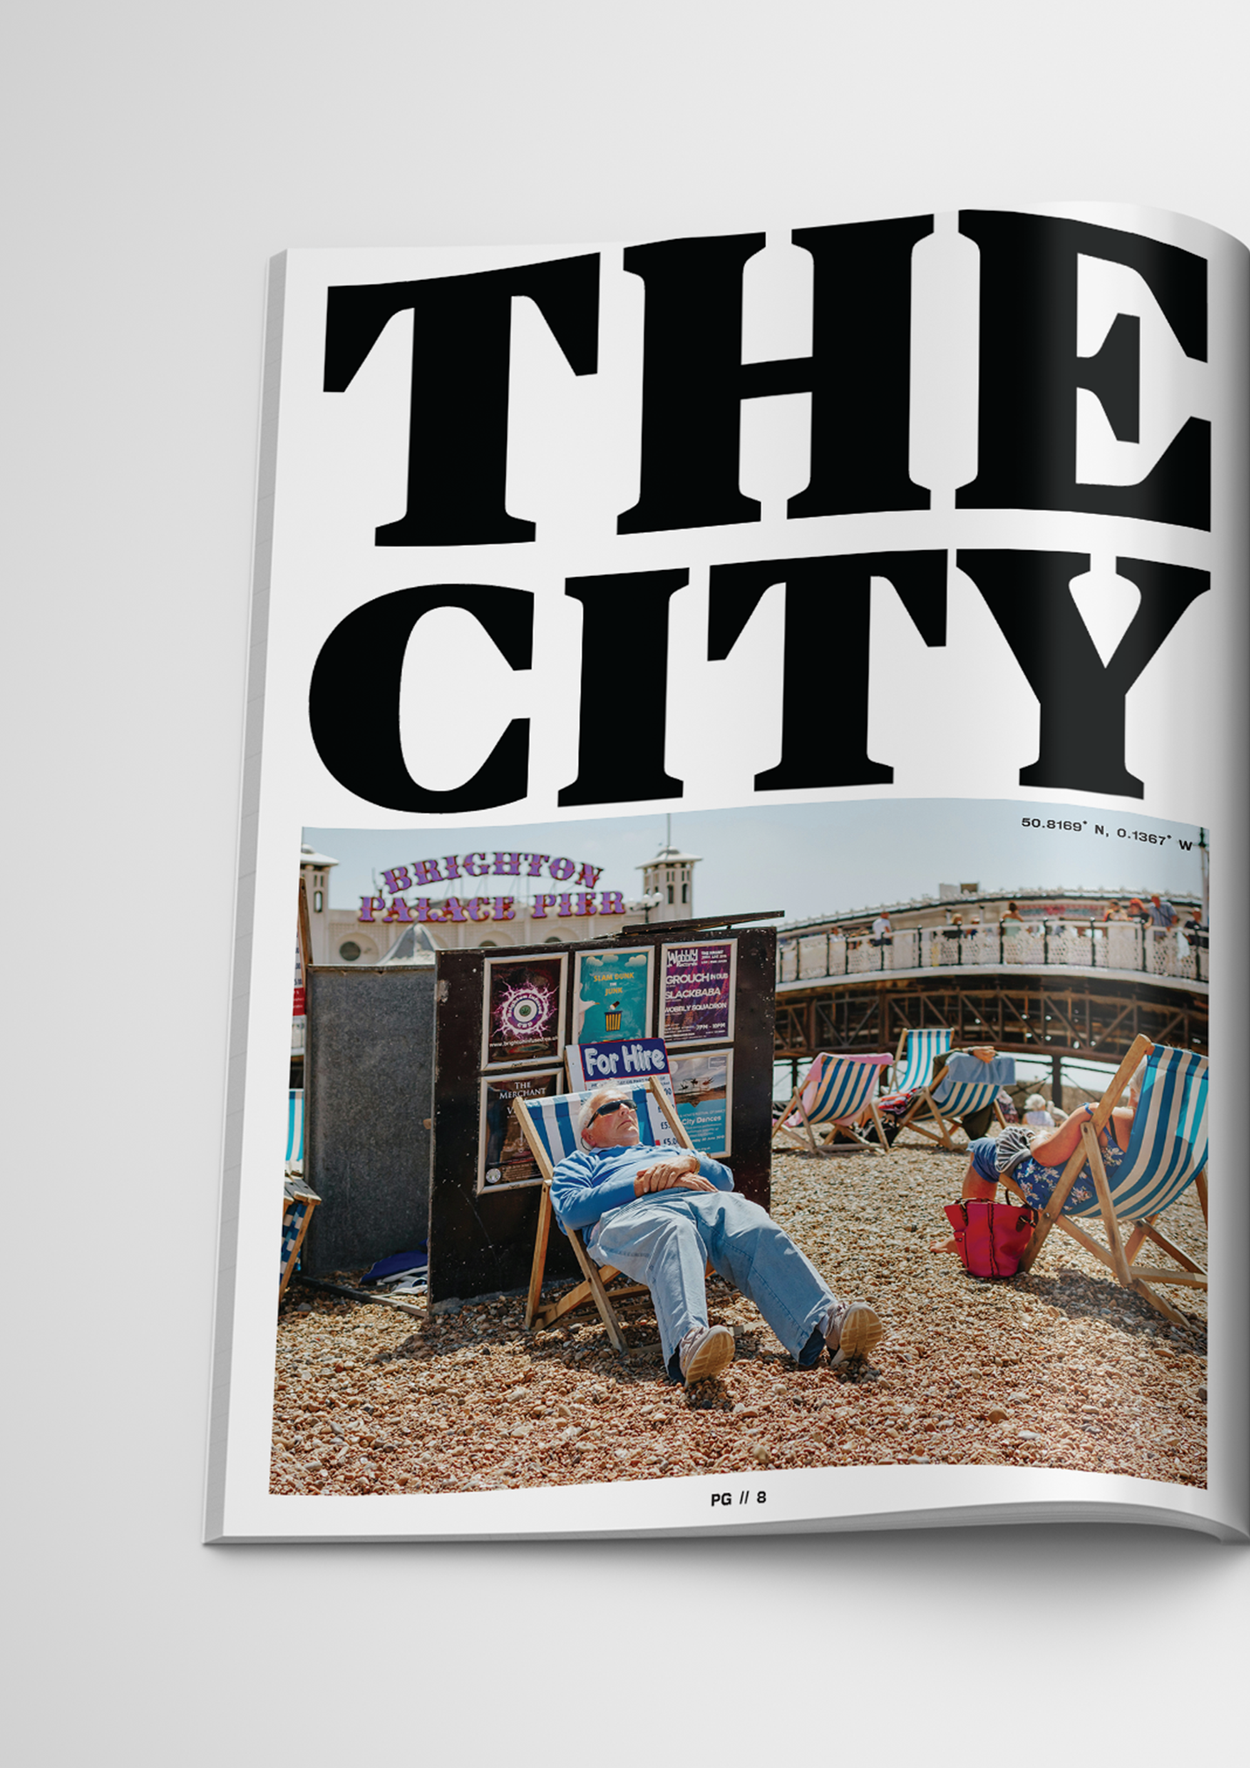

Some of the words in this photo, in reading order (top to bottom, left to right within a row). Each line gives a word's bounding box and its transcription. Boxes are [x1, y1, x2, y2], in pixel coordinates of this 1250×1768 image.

[323, 209, 1212, 547] THE
[308, 549, 1212, 814] CITY
[1021, 817, 1088, 832] 50.8169°
[1094, 825, 1109, 837] N,
[1117, 828, 1172, 845] 0.1367°
[1178, 839, 1193, 851] W
[381, 852, 604, 894] BRIGHTON
[358, 896, 516, 923] PALACE
[531, 891, 626, 919] PIER
[593, 974, 613, 983] SLAM
[665, 972, 710, 985] GROUCH
[604, 987, 623, 996] JUNK
[665, 987, 721, 1000] SLACKBABA
[584, 1047, 619, 1076] For
[621, 1043, 666, 1072] Hire
[682, 1117, 695, 1126] City
[696, 1115, 722, 1124] Dances
[711, 1492, 732, 1507] PG
[756, 1490, 767, 1504] 8
